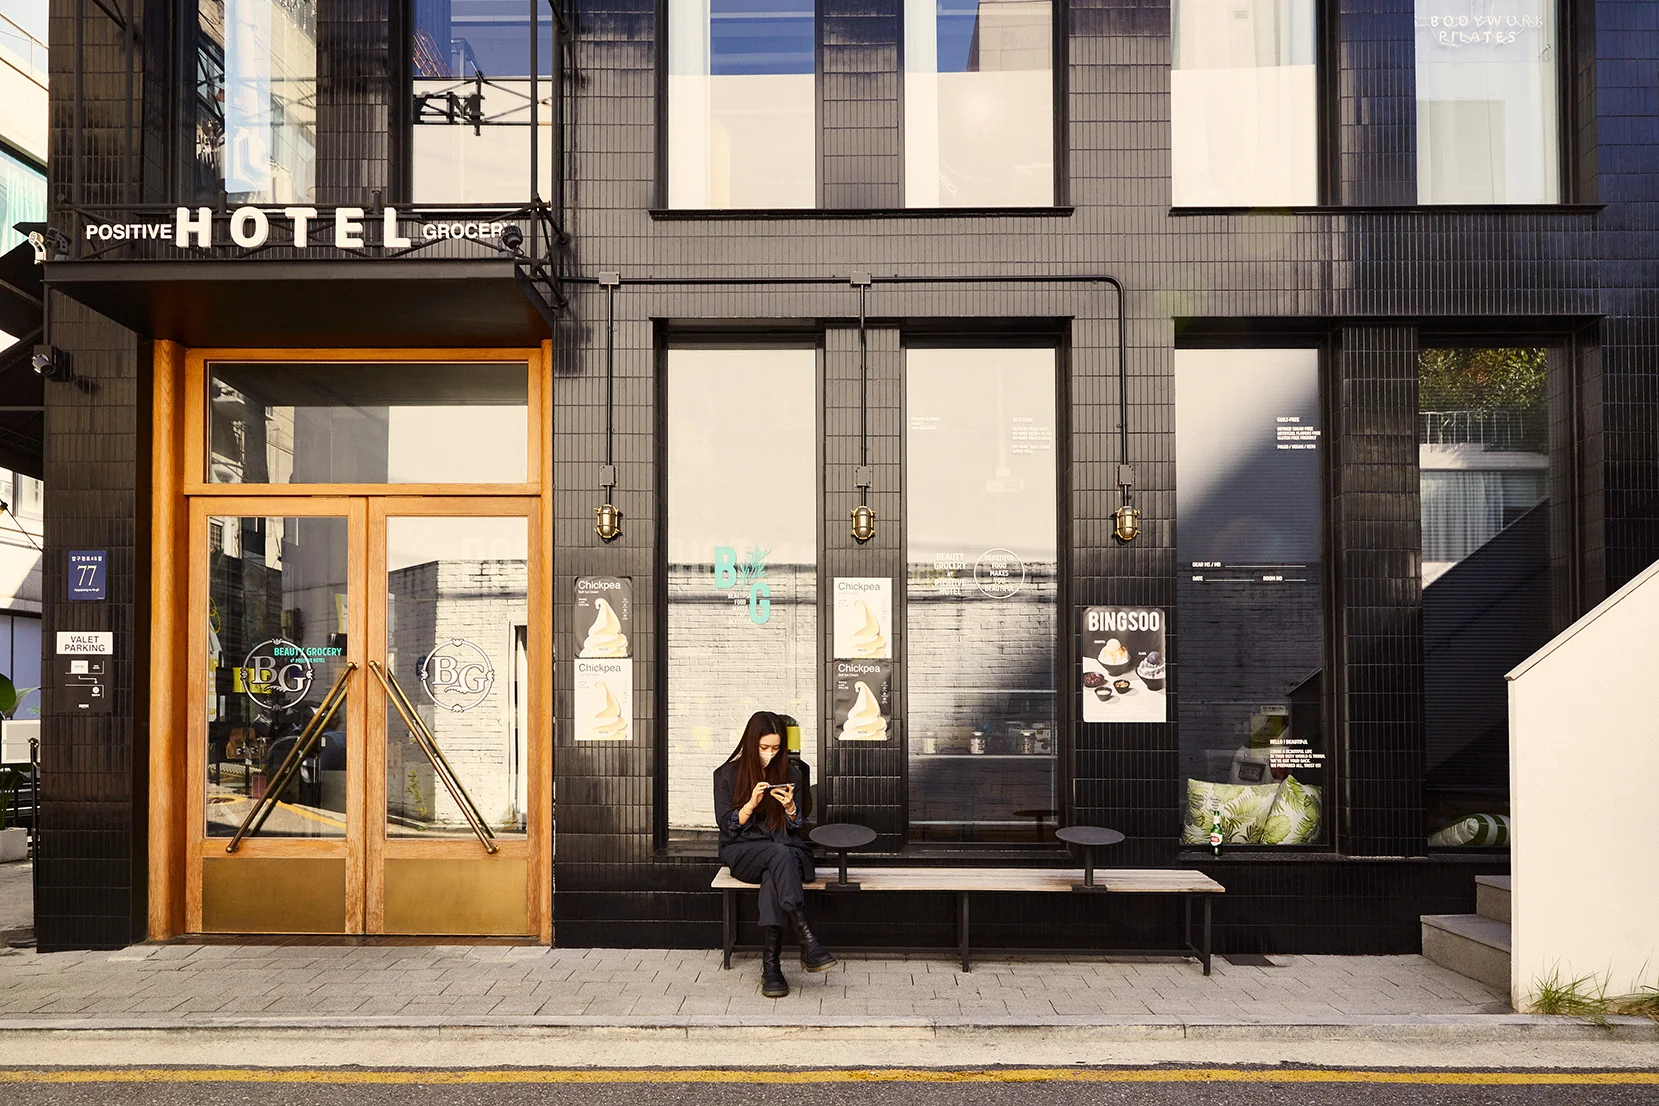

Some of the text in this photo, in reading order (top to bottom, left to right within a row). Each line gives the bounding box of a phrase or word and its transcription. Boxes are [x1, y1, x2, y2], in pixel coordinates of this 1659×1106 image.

[1430, 15, 1543, 27] BODYWORK
[1439, 31, 1516, 43] PILATES
[86, 206, 515, 249] POSITIVE HOTEL GROCER
[714, 546, 737, 589] B
[934, 561, 967, 569] GROCERY
[77, 565, 97, 586] 77
[578, 580, 621, 591] Chickpea
[838, 582, 880, 592] Chickpea
[934, 579, 966, 587] POSITIVE
[940, 587, 961, 595] HOTEL
[749, 582, 771, 625] G
[1088, 611, 1160, 632] BINGSOO
[64, 644, 105, 652] PARKING
[274, 647, 342, 656] BEAUTY GROCERY
[578, 663, 621, 674] Chickpea
[838, 663, 880, 674] Chickpea
